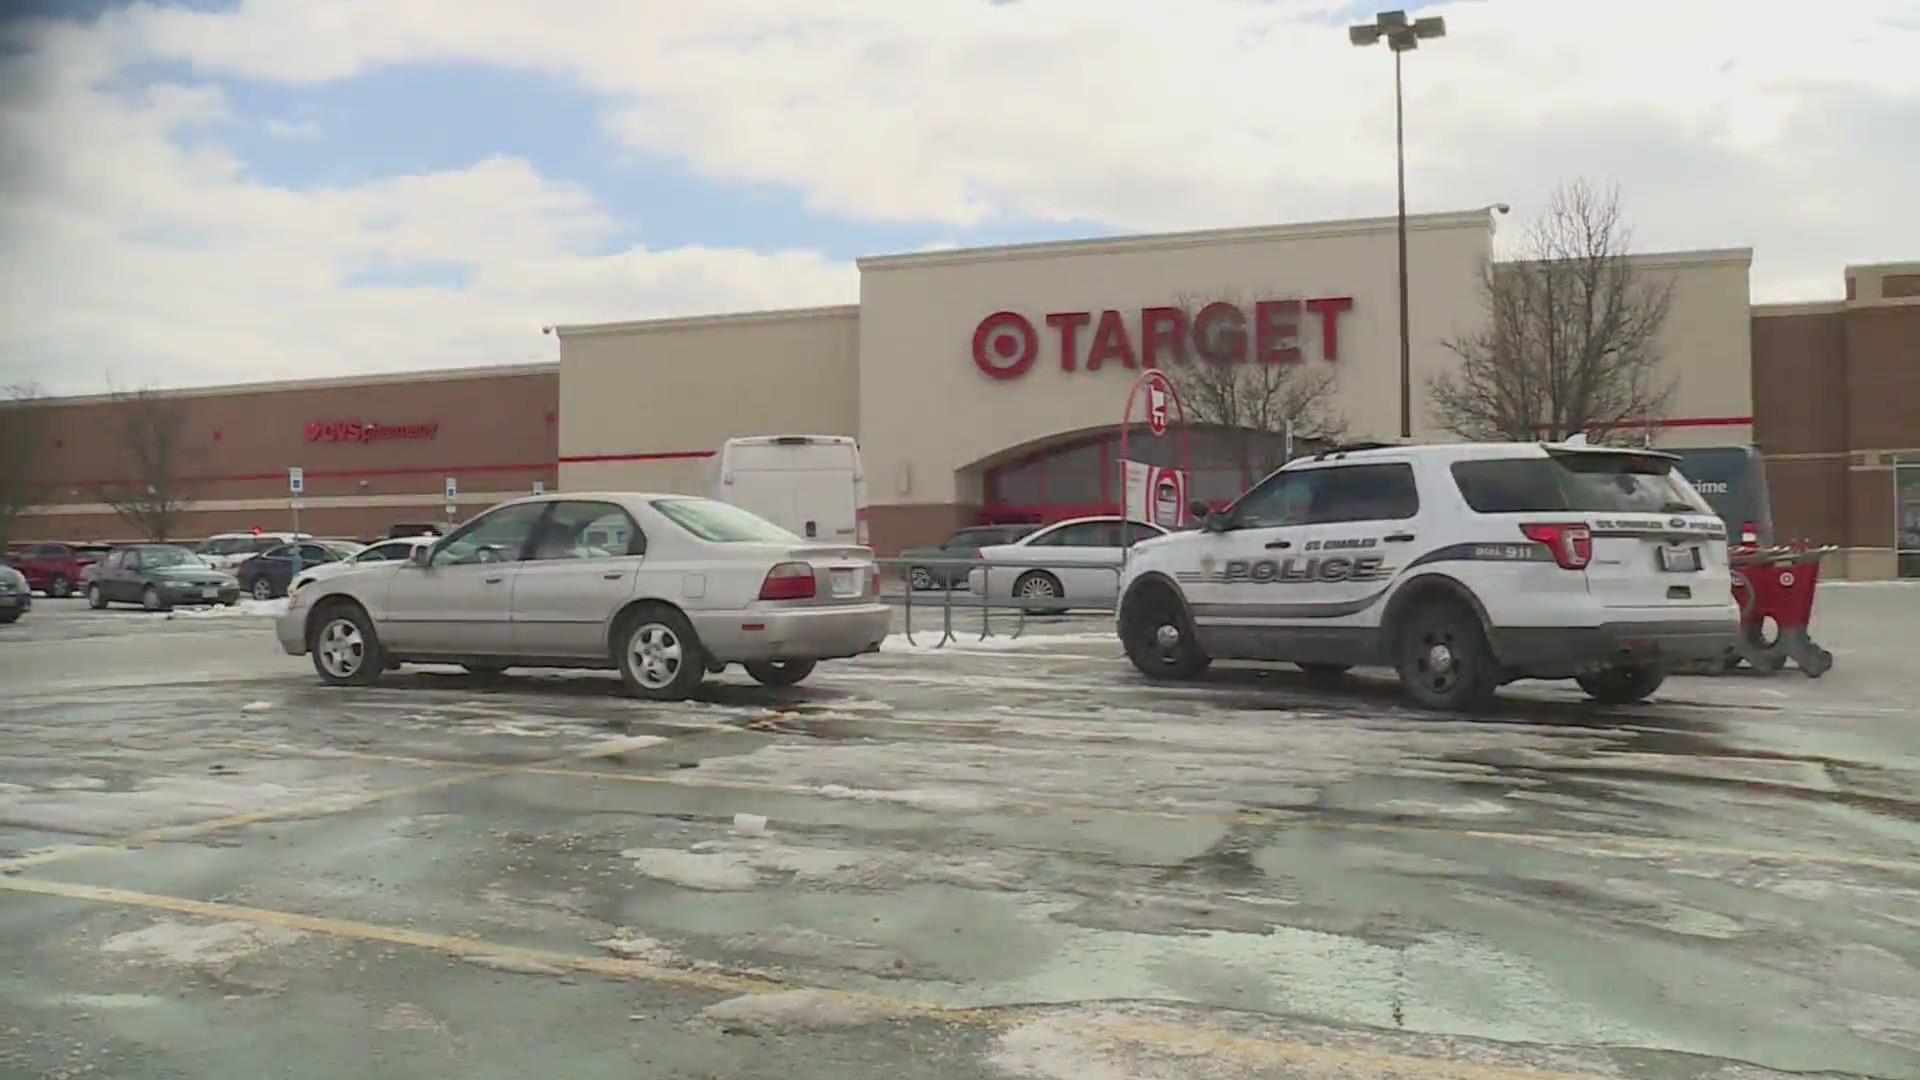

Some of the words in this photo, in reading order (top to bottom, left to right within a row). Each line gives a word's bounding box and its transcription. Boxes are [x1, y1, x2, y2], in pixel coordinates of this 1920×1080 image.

[1045, 297, 1353, 371] TARGET
[1690, 479, 1728, 494] ime
[1323, 537, 1377, 550] CHARLES
[1505, 546, 1532, 559] 911
[1222, 555, 1385, 583] POLICE
